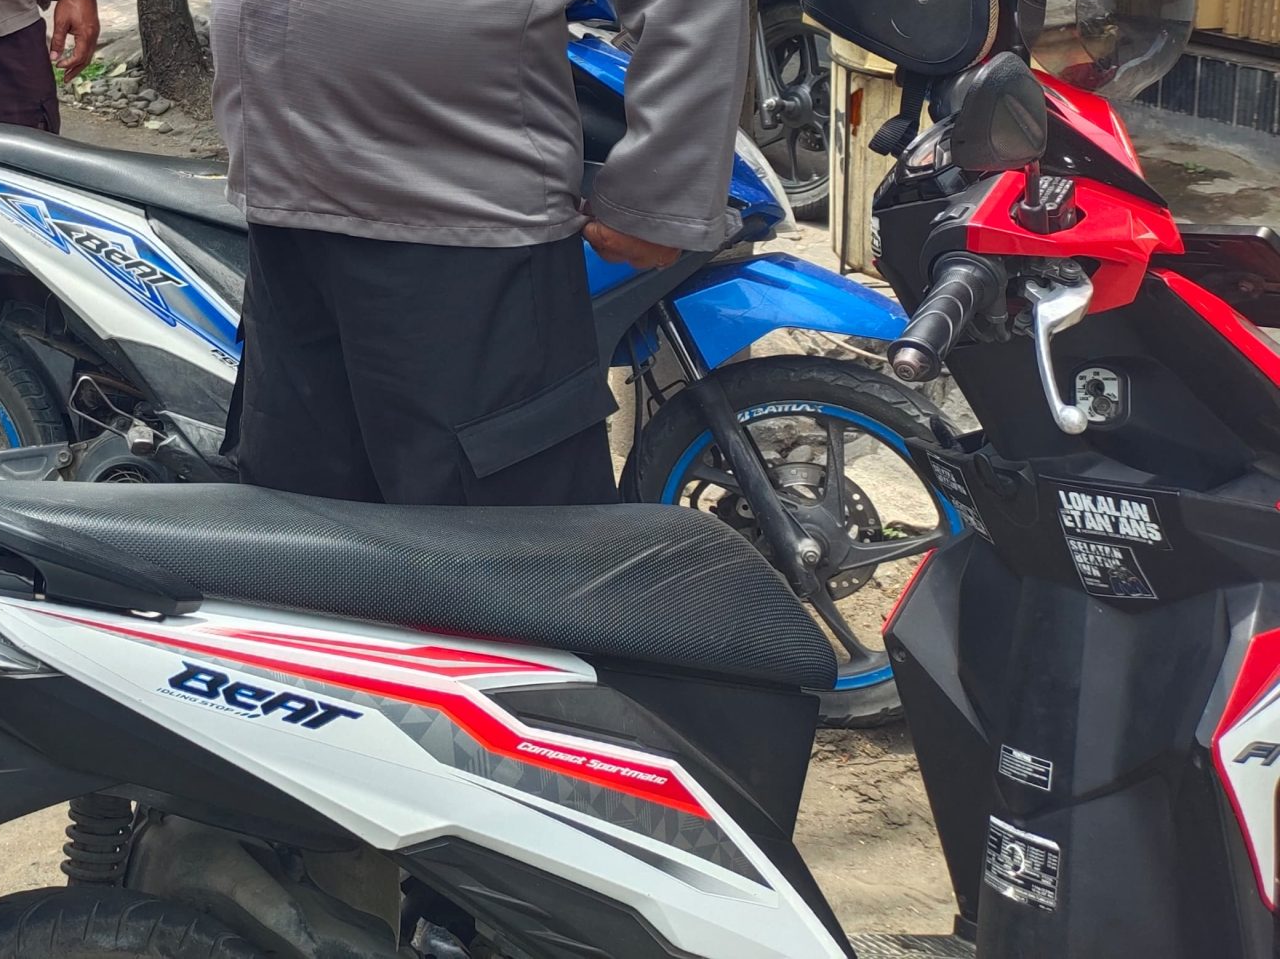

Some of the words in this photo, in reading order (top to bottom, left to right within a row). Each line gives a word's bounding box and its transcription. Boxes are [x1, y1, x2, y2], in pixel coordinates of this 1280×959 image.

[156, 687, 197, 703] IDLING
[199, 699, 234, 713] STOP
[516, 742, 587, 765] Compact
[586, 759, 668, 785] Sportmatic
